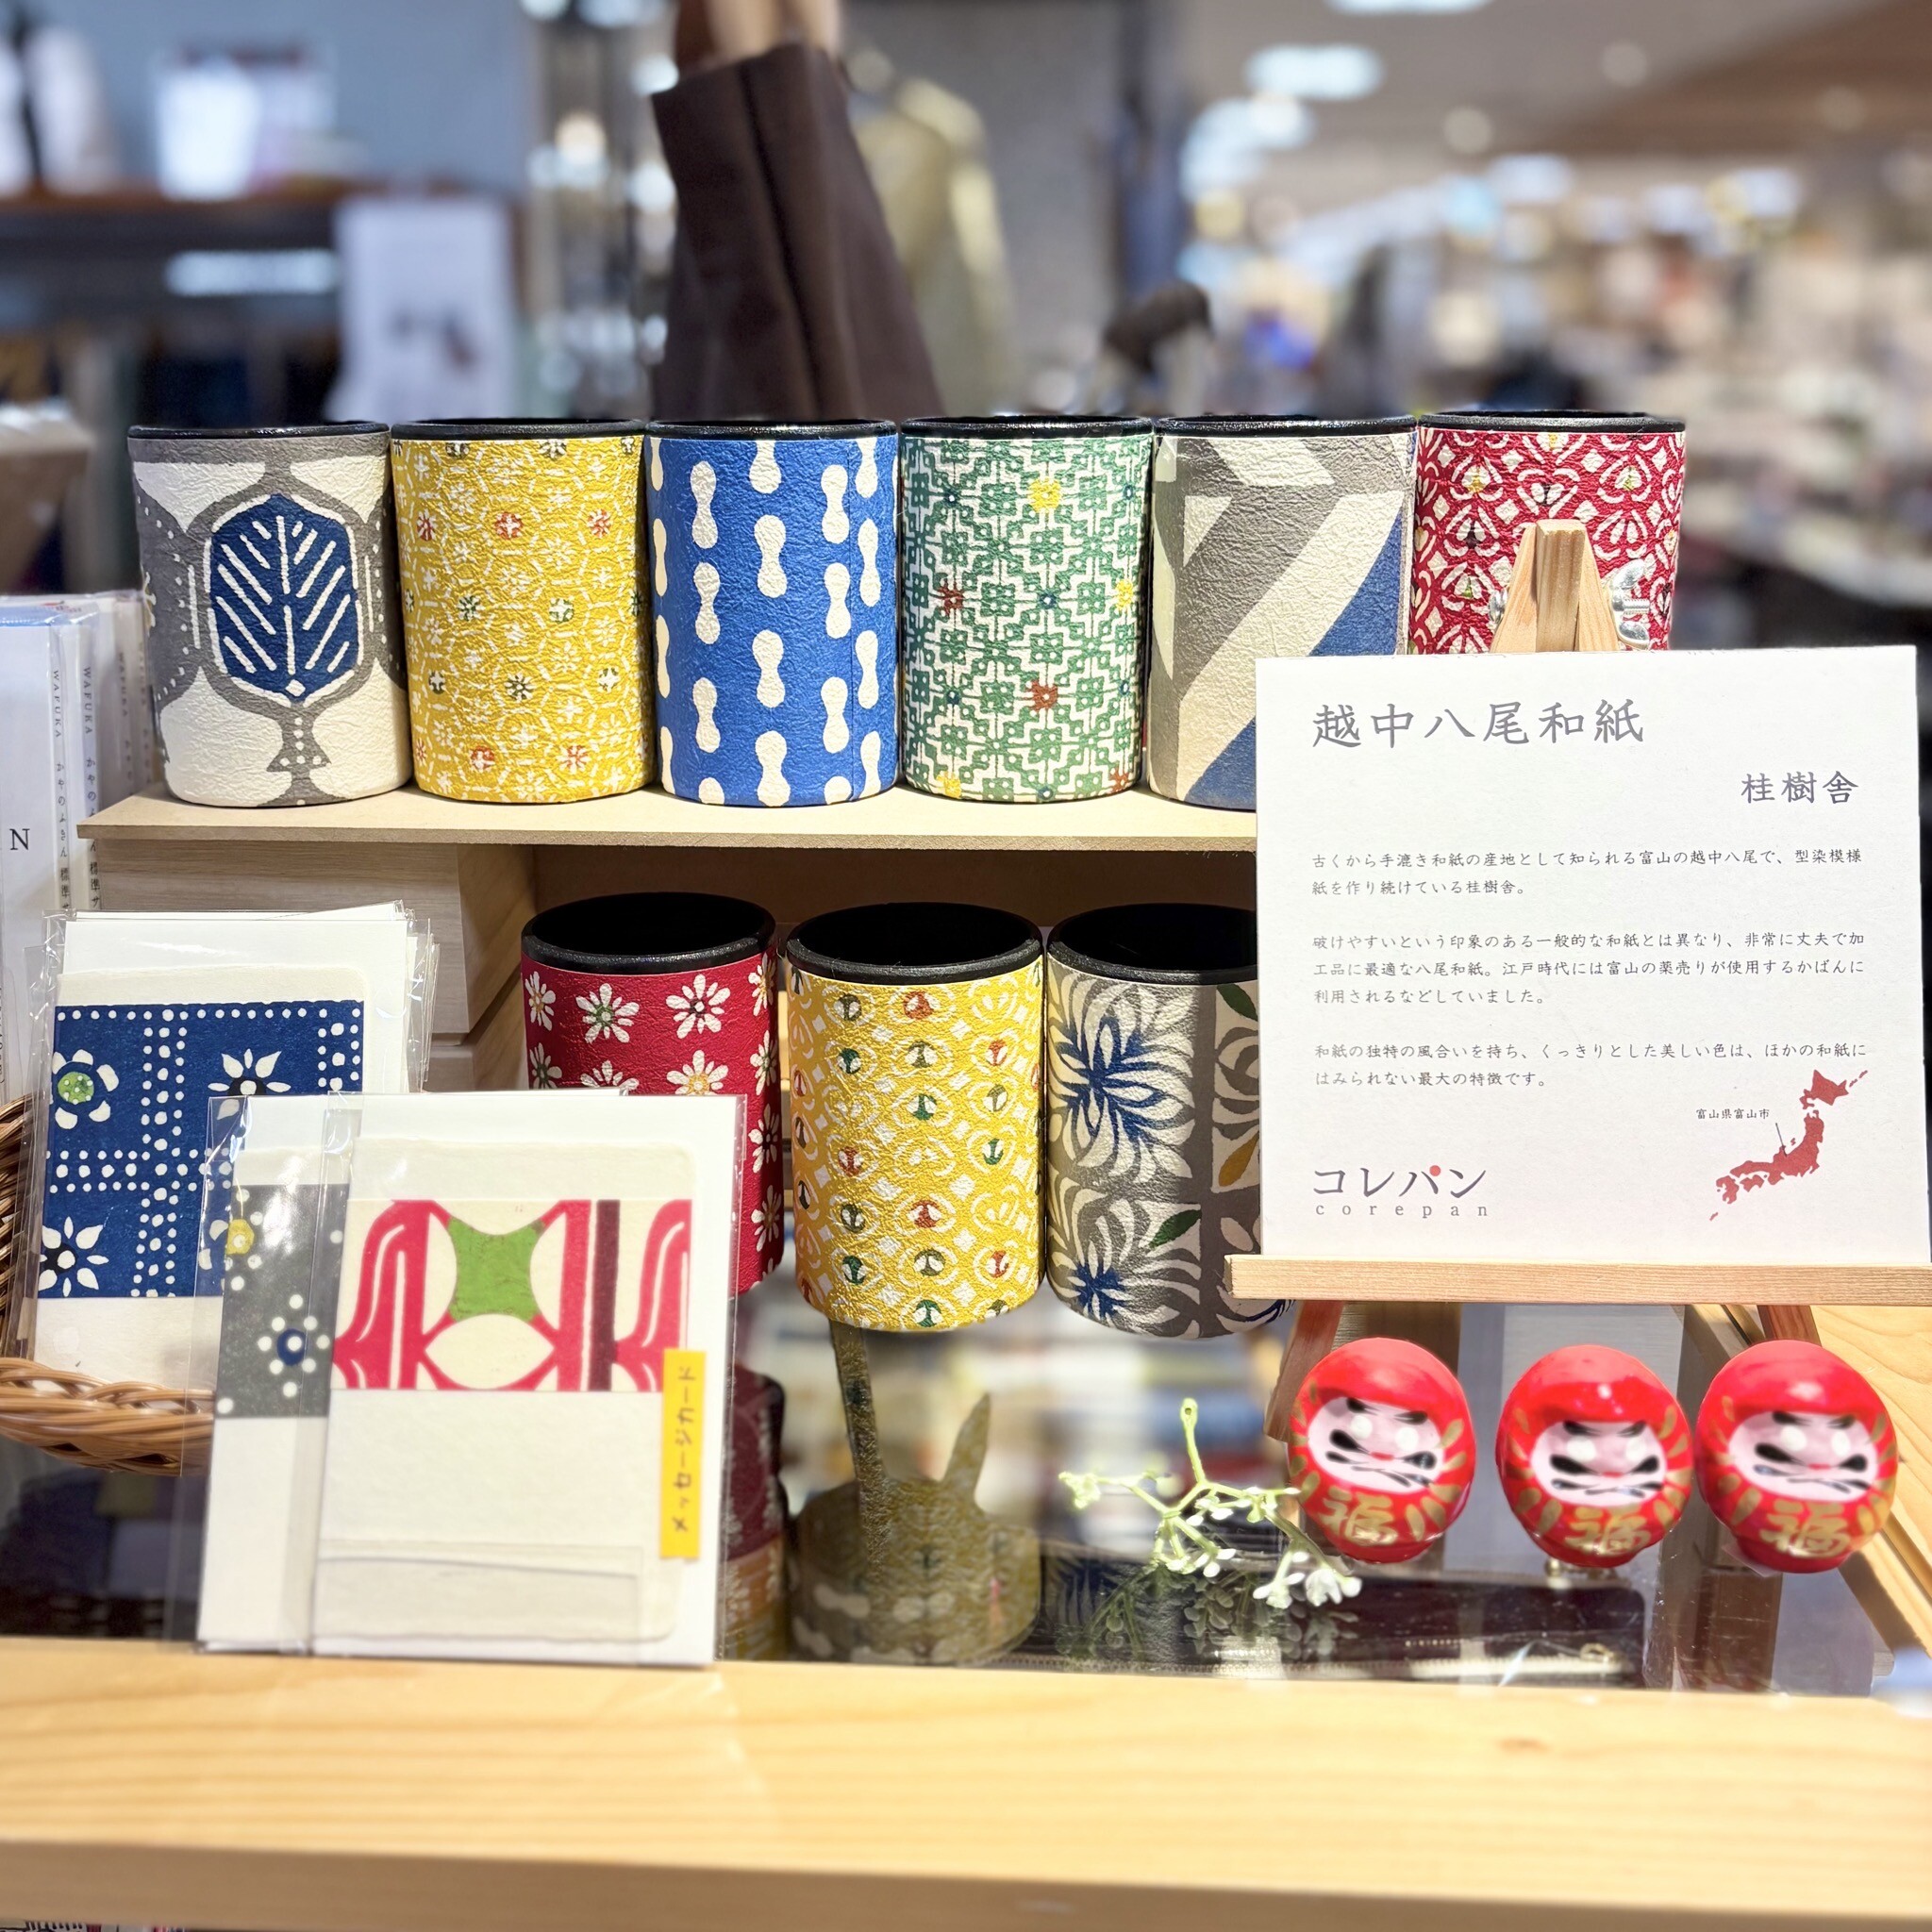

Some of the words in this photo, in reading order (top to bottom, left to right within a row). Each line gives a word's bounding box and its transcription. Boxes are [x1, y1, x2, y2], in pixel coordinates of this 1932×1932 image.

[83, 666, 93, 735] WAFUKA
[1312, 698, 1644, 749] 越中八尾和紙
[1740, 770, 1859, 805] 桂樹舎
[1312, 847, 1862, 868] 古くから手漉き和紙の産地として知られる富山の越中八尾で、型染模様
[1311, 879, 1524, 895] 紙を作り続けている桂樹舎。
[1312, 931, 1864, 950] 破けやすいという印象のある一般的な和紙とは異なり、非常に丈夫で加
[1313, 989, 1544, 1005] 利用されるなどしていました。
[1314, 1042, 1867, 1059] 和紙の独特の風合いを持ち、くっきりとした美しい色は、ほかの和紙に
[1315, 1071, 1545, 1087] はみられない最大の特徴です。
[1695, 1108, 1770, 1120] 富山県富山市
[1313, 1164, 1487, 1199] コレパン
[1315, 1205, 1488, 1219] corepan
[671, 1365, 696, 1533] メッセージカード
[1320, 1486, 1398, 1544] 福
[1565, 1503, 1651, 1555] 福
[1758, 1498, 1851, 1559] 福
